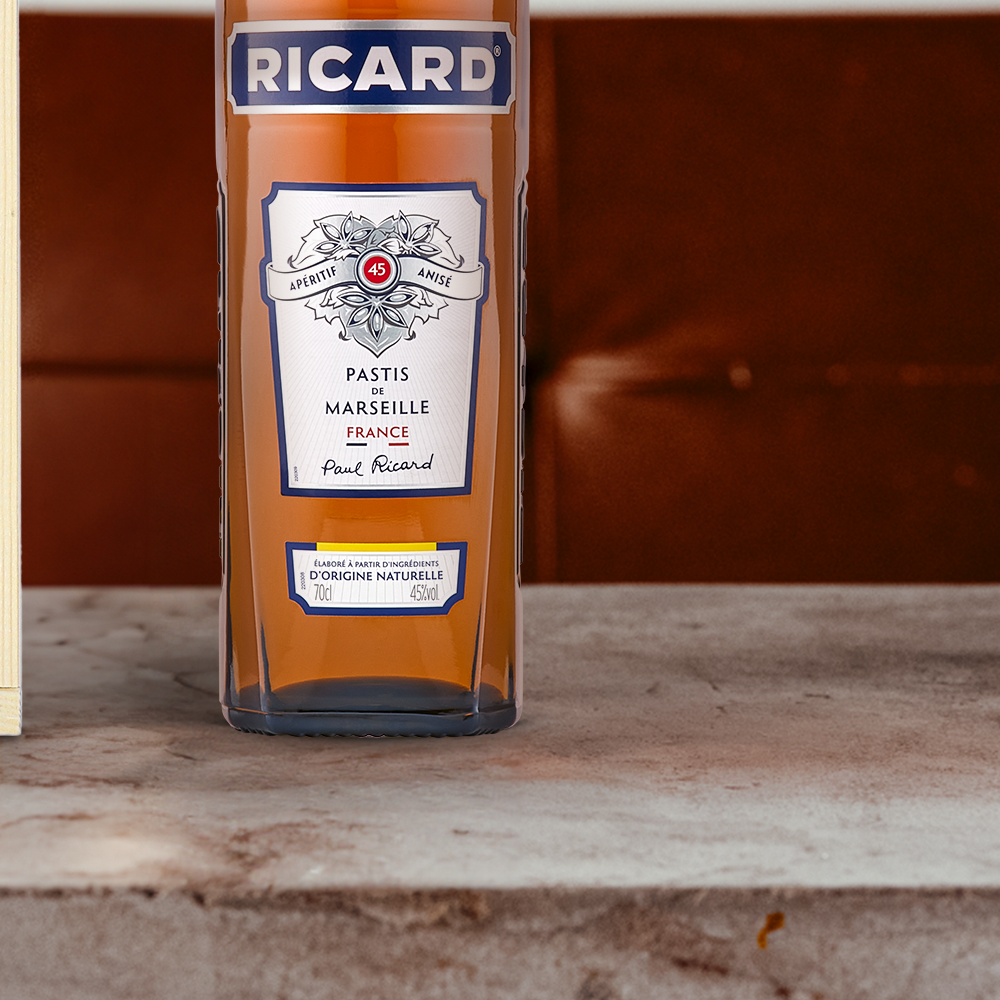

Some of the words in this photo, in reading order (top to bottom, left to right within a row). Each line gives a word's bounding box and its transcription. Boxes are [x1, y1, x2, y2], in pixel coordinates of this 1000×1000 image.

[367, 263, 387, 277] 45
[417, 267, 453, 288] ANISÉ
[289, 265, 338, 291] APÉRITIF
[346, 367, 409, 382] PASTIS
[371, 387, 385, 396] DE
[325, 400, 430, 415] MARSEILLE
[346, 426, 410, 438] FRANCE
[321, 459, 364, 477] Paul
[371, 453, 434, 474] Ricard
[314, 559, 346, 568] ÉLABORÉ
[348, 559, 353, 568] À
[355, 560, 380, 568] PARTIR
[382, 559, 439, 568] D'INGRÉDIENTS
[309, 570, 372, 581] D'ORIGINE
[376, 570, 444, 581] NATURELLE
[314, 584, 332, 601] 70cl
